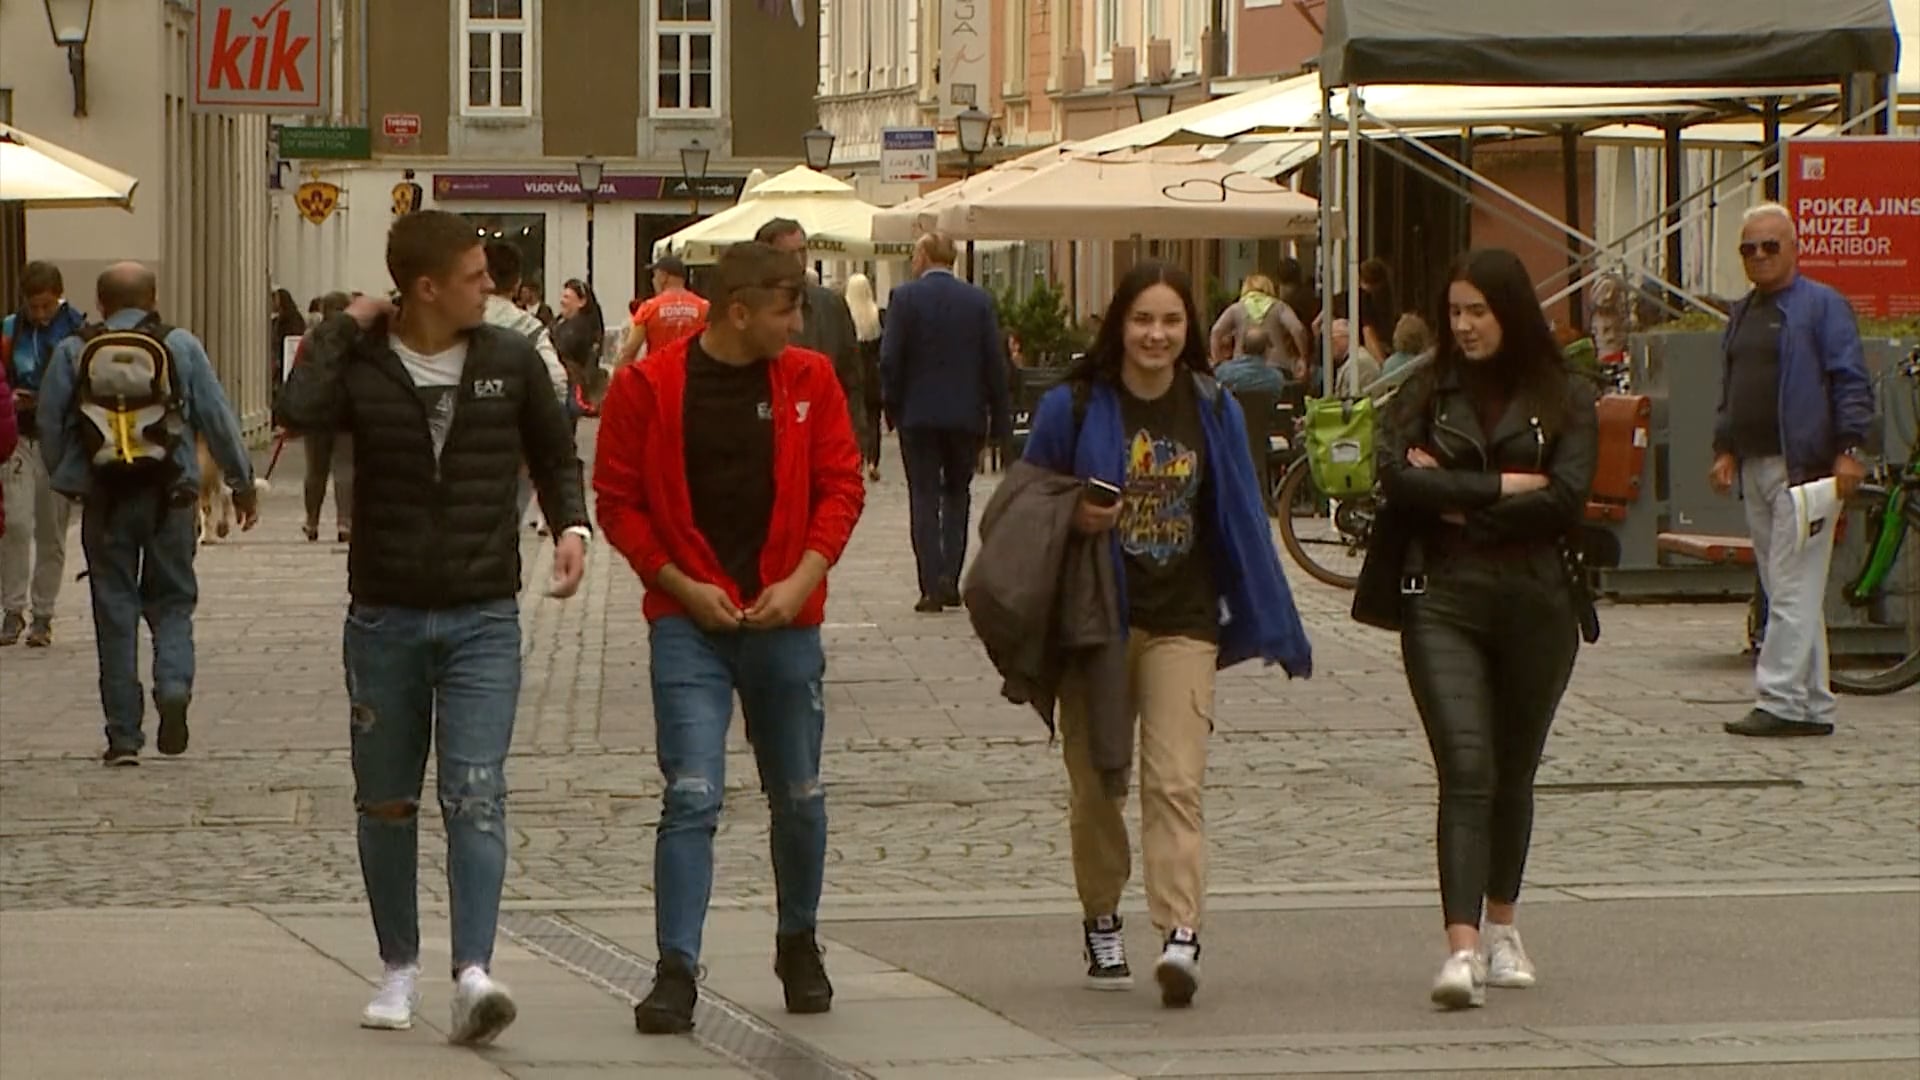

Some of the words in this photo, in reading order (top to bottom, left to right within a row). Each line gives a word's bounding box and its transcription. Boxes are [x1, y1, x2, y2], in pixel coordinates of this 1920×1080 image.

[207, 7, 311, 92] kik
[1799, 198, 1920, 216] POKRAJINS
[1799, 218, 1870, 236] MUZEJ
[874, 243, 914, 255] FRUCT
[1799, 237, 1891, 255] MARIBOR
